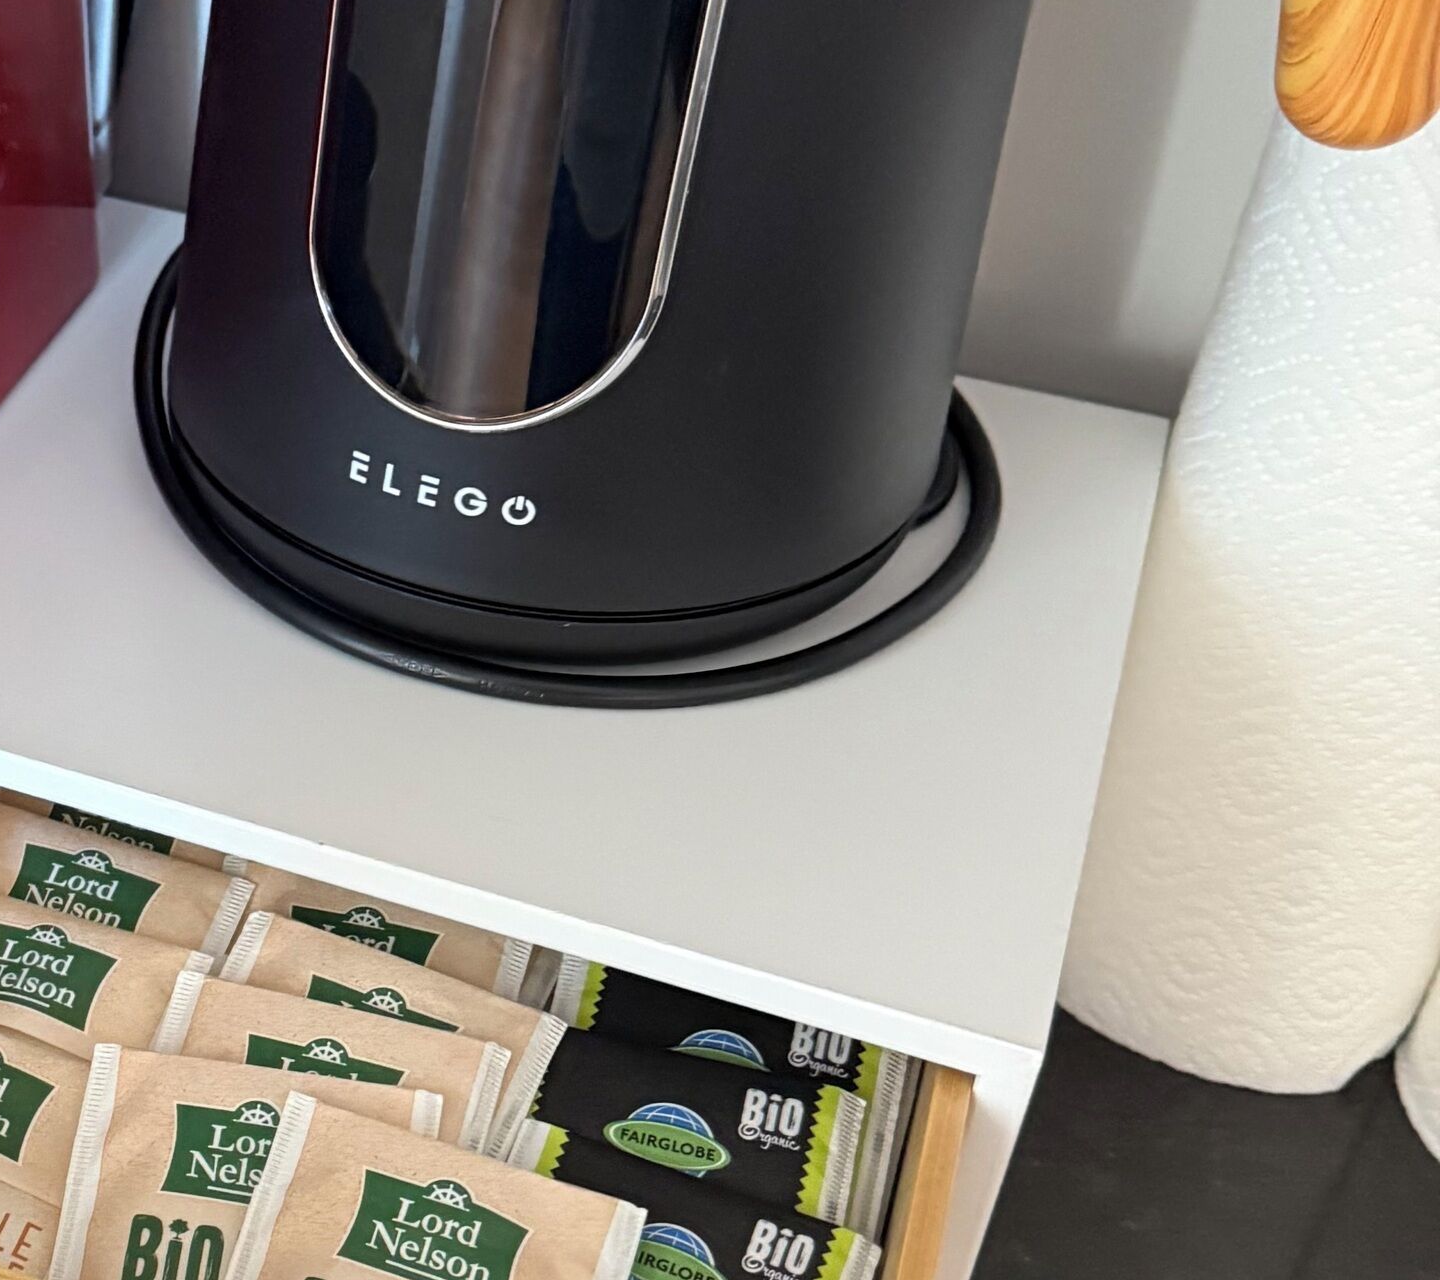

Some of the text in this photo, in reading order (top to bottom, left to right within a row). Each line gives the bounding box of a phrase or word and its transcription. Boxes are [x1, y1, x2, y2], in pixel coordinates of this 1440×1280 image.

[349, 450, 537, 526] ELEGO
[44, 862, 119, 902] Lord
[24, 883, 121, 929] Nelson
[788, 1050, 849, 1078] Organic
[208, 1124, 272, 1157] Lor
[620, 1127, 716, 1162] FAIRGLOBE
[738, 1121, 800, 1151] Organic
[186, 1150, 263, 1188] Nels
[392, 1197, 482, 1248] Lord
